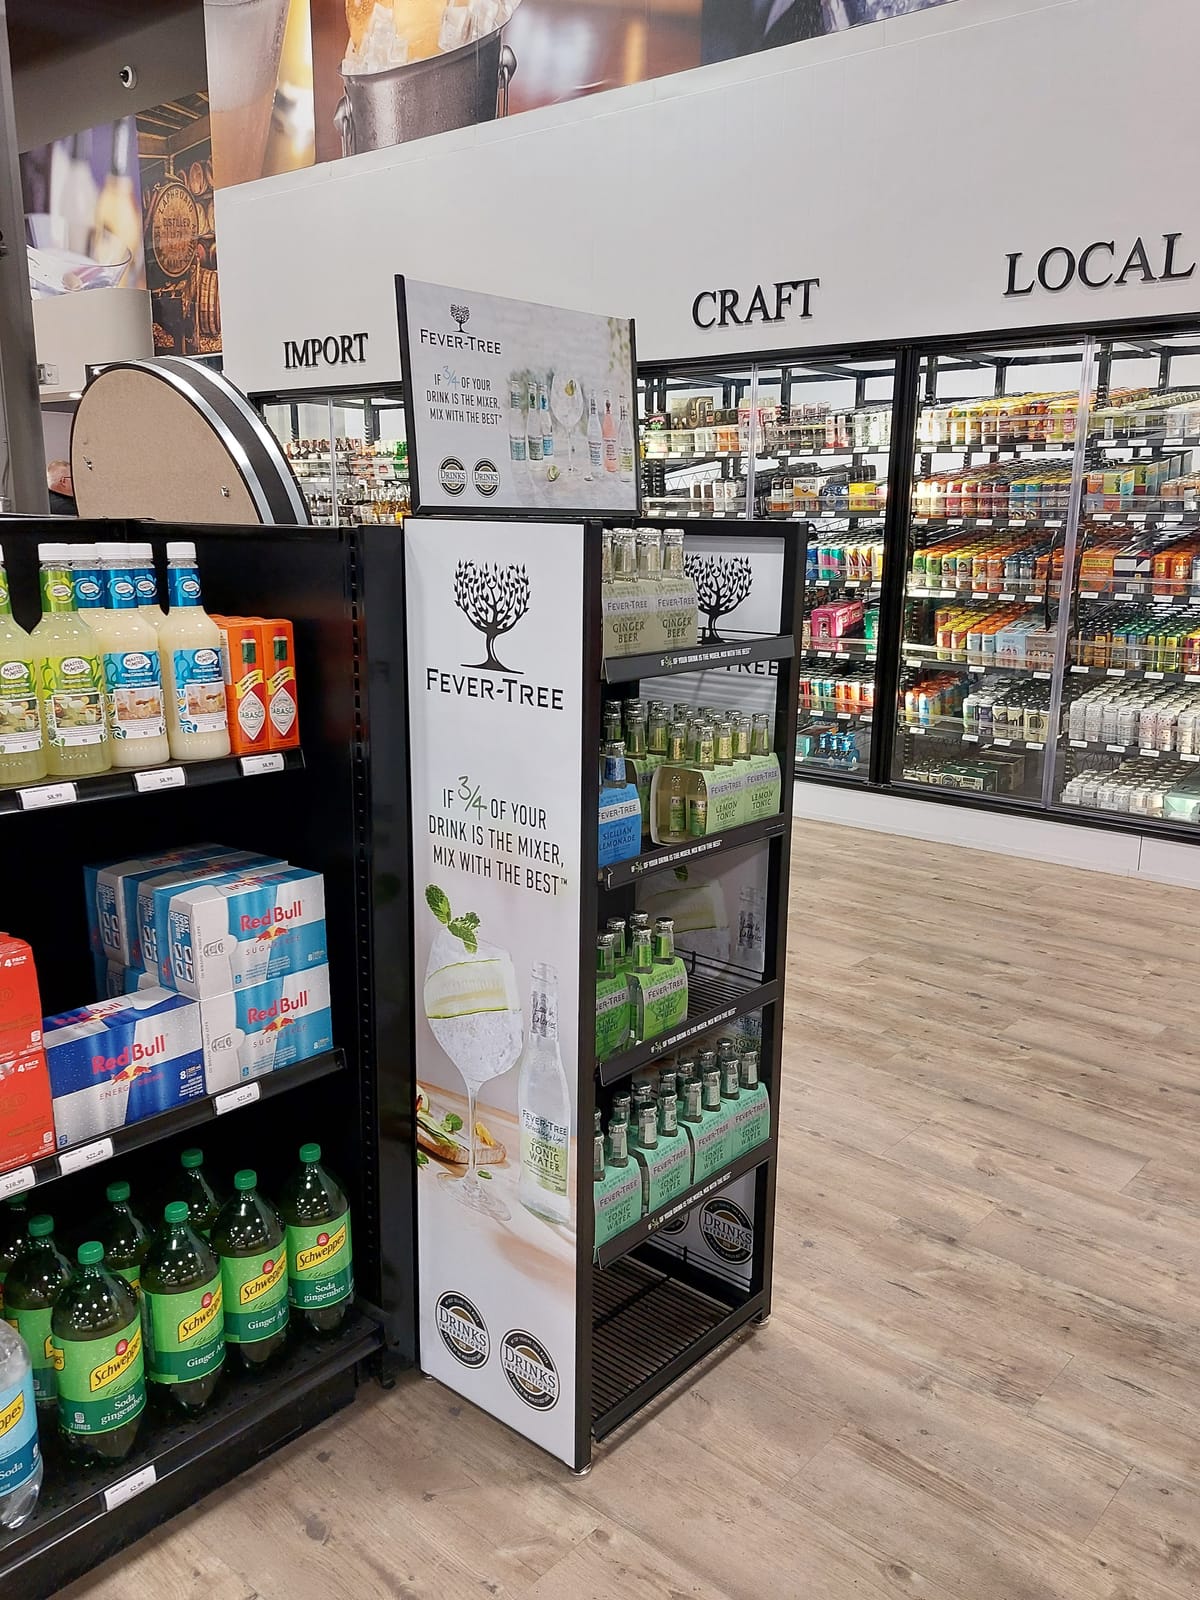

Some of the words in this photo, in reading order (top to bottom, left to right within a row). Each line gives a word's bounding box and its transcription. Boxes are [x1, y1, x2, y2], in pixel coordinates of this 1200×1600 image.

[1003, 232, 1196, 298] LOCAL
[691, 277, 821, 329] CRAFT
[283, 332, 369, 369] IMPORT
[420, 329, 502, 355] FEVER-TREE
[434, 374, 442, 386] IF
[442, 365, 460, 390] 3/4
[461, 376, 471, 388] OF
[471, 378, 491, 391] YOUR
[426, 391, 450, 404] DRINK
[451, 393, 459, 404] IS
[461, 395, 474, 407] THE
[476, 396, 500, 410] MIXER,
[430, 408, 444, 420] MIX
[445, 410, 464, 422] WITH
[466, 412, 480, 424] THE
[440, 469, 466, 480] DRINKS
[474, 471, 499, 481] DRINKS
[607, 600, 648, 611] FEVER-TREE
[657, 597, 695, 607] FEVER-TREE
[612, 621, 645, 633] GINGER
[662, 617, 692, 629] GINGER
[618, 632, 639, 644] BEER
[667, 628, 687, 639] BEER
[426, 667, 564, 710] FEVER-TREE
[746, 771, 778, 784] FEVER-TREE
[710, 781, 742, 795] FEVER-TREE
[751, 790, 774, 802] LEMON
[442, 788, 455, 809] IF
[457, 775, 487, 821] 3/4
[490, 797, 507, 820] OF
[511, 801, 547, 830] YOUR
[715, 800, 738, 814] LEMON
[752, 798, 772, 810] TONIC
[600, 804, 637, 820] EVER-TREE
[716, 810, 736, 821] TONIC
[428, 814, 468, 842] DRINK
[471, 823, 484, 845] IS
[488, 827, 513, 853] THE
[518, 835, 565, 869] MIXER,
[432, 844, 455, 867] MIX
[459, 850, 492, 877] WITH
[496, 860, 521, 886] THE
[240, 908, 272, 933] Red
[273, 900, 302, 923] Bull
[4, 959, 13, 968] 4
[647, 978, 684, 1000] FEVER-TREE
[89, 1002, 123, 1014] Bull
[247, 999, 278, 1025] Red
[279, 990, 308, 1014] Bull
[91, 1046, 129, 1075] Red
[131, 1034, 165, 1062] Bull
[17, 1064, 25, 1073] 4
[24, 1059, 40, 1067] PACK
[180, 1070, 187, 1080] 8
[522, 1109, 568, 1136] FEVER-TREE
[529, 1150, 561, 1173] WATER
[530, 1142, 560, 1163] TONIC
[607, 1212, 631, 1231] WATER
[608, 1203, 631, 1223] TONIC
[704, 1212, 753, 1245] DRINKS
[299, 1233, 344, 1268] Schweppes
[303, 1285, 345, 1303] gingembre
[315, 1282, 336, 1293] Soda
[247, 1314, 276, 1330] Ginger
[440, 1307, 487, 1348] DRINKS
[186, 1350, 215, 1368] Ginger
[505, 1346, 556, 1390] DRINKS
[114, 1393, 136, 1411] Soda
